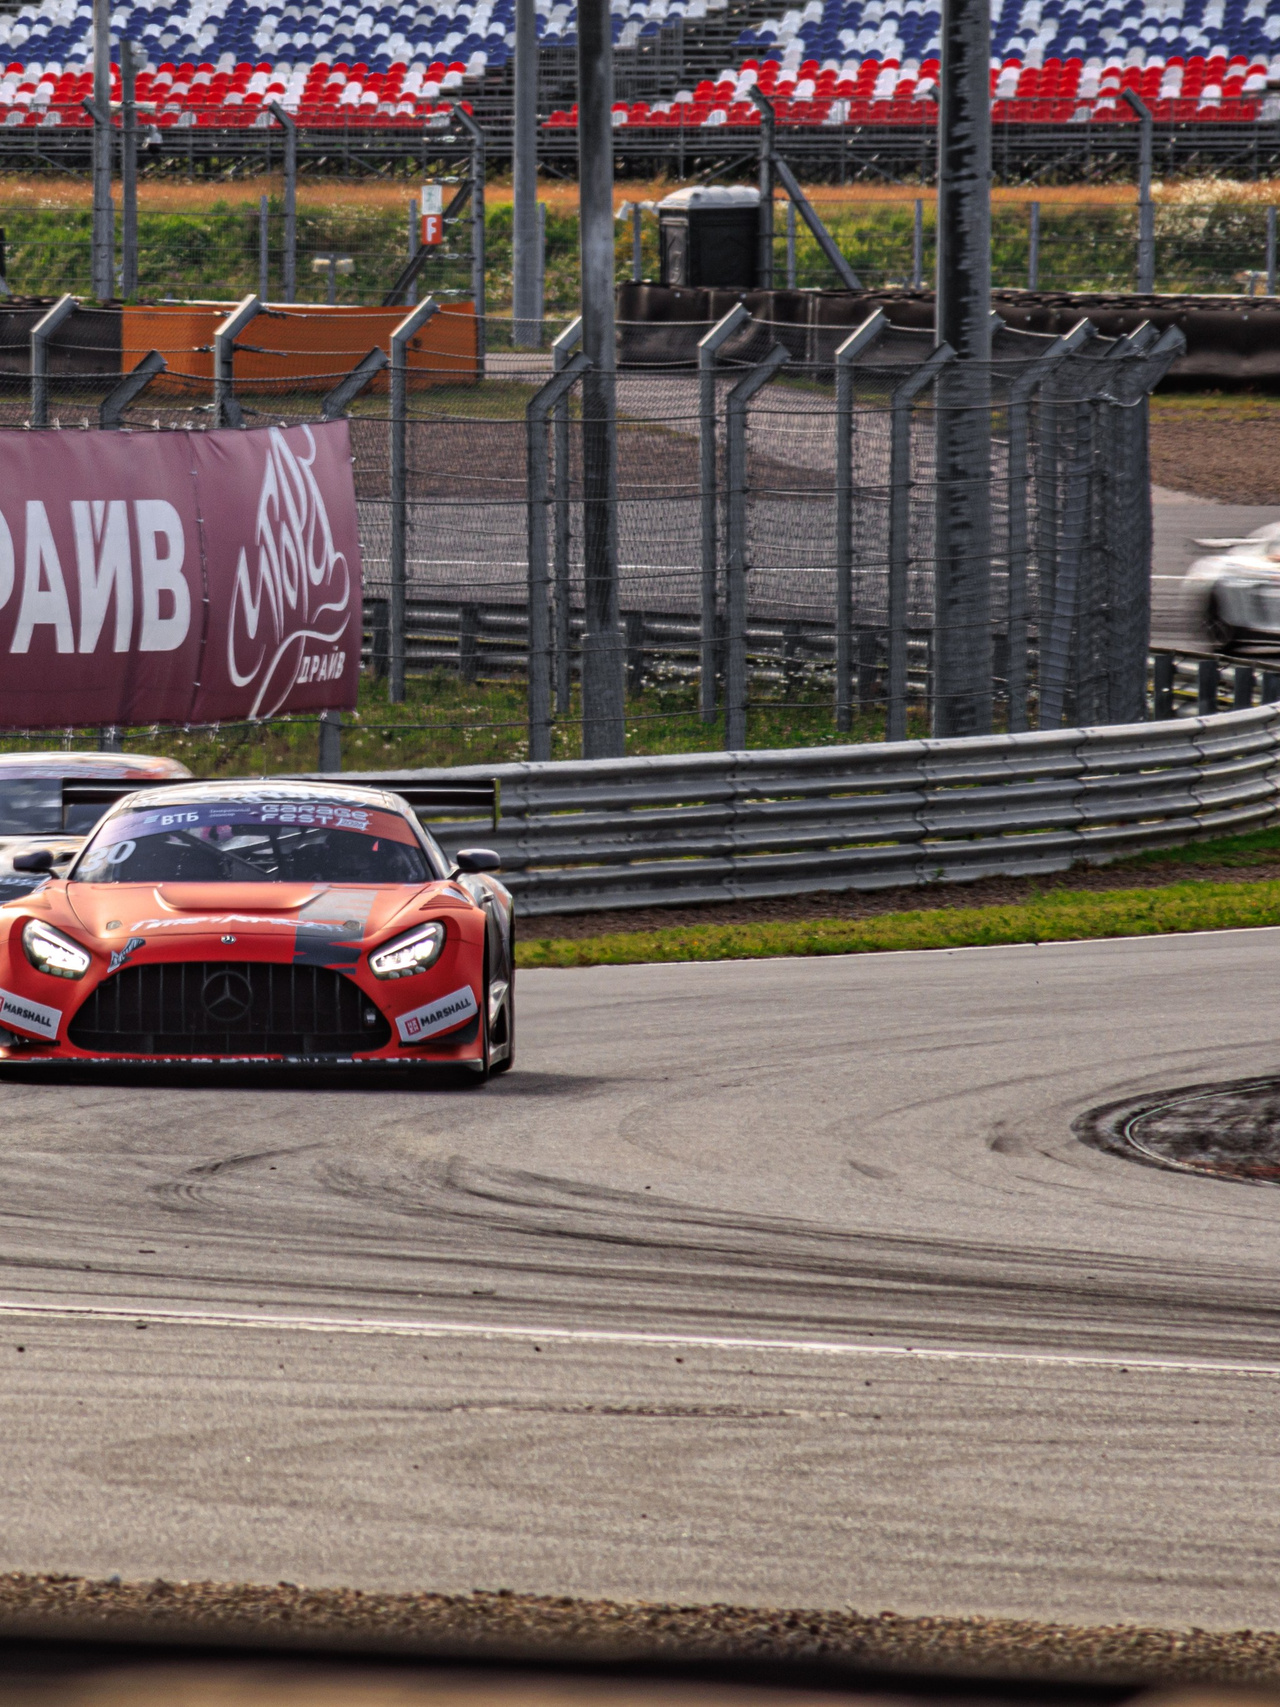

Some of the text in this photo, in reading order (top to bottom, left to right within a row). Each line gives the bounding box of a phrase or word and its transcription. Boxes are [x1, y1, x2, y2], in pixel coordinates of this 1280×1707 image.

[426, 217, 437, 242] F
[297, 645, 345, 683] ДРАЙВ
[160, 811, 199, 826] ВТБ
[77, 840, 137, 873] 30
[4, 1002, 52, 1027] MARSHALL
[420, 998, 472, 1027] MARSHALL
